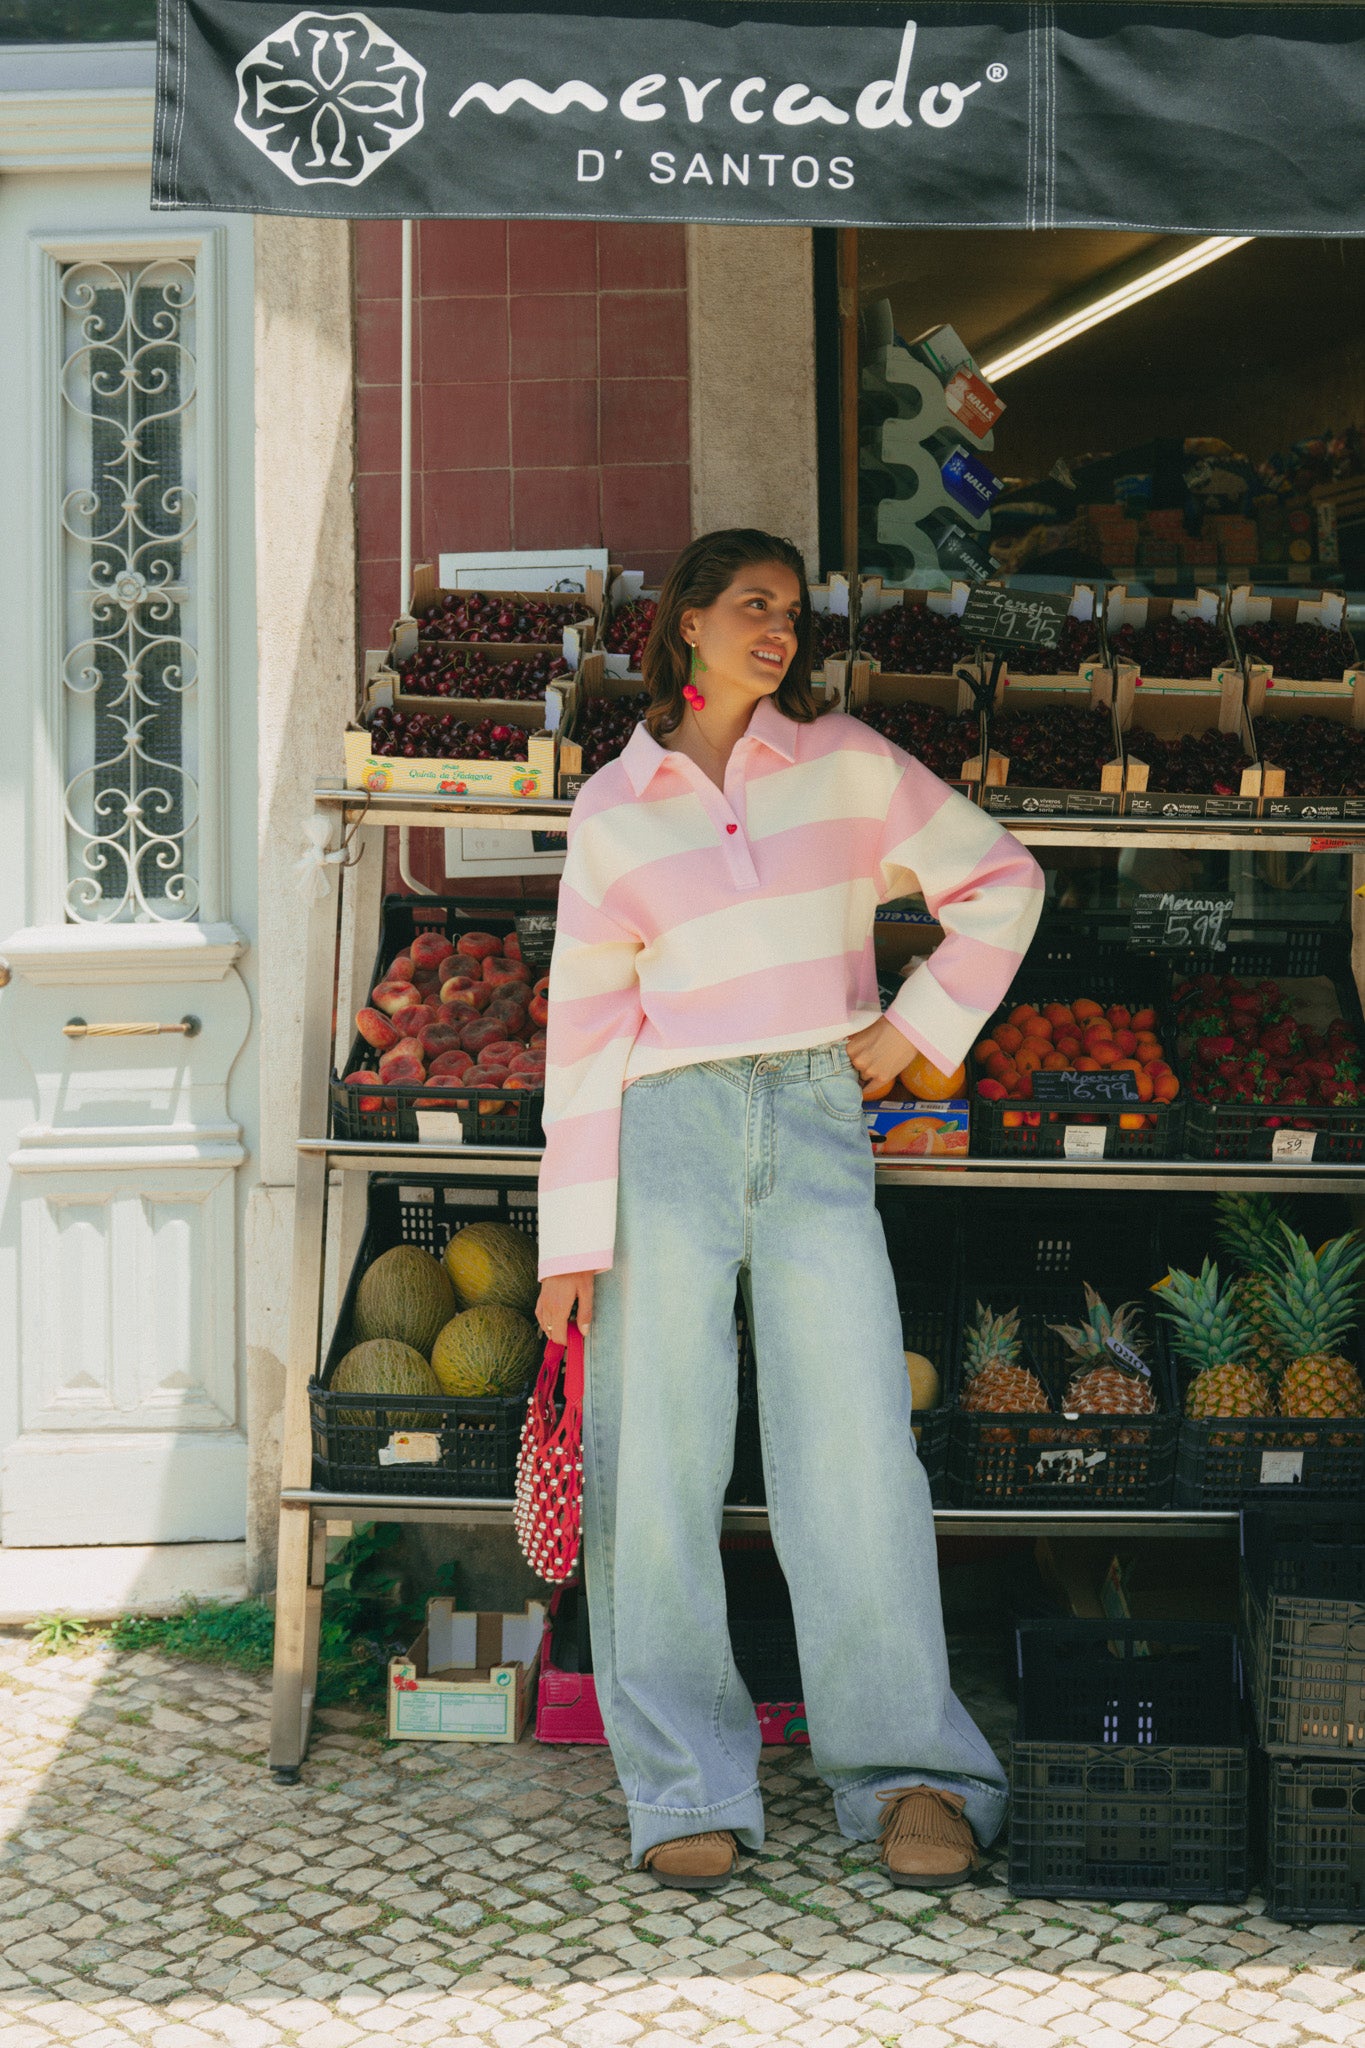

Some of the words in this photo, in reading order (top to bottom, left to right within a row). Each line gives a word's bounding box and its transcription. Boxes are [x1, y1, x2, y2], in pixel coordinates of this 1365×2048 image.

[448, 20, 982, 129] mercado
[649, 151, 855, 190] SANTOS
[966, 392, 995, 419] HALLS
[963, 471, 992, 500] HALLS
[960, 552, 989, 579] HALLS
[993, 594, 1056, 618] Cereja
[1000, 612, 1061, 641] 9.95
[1159, 893, 1234, 917] Morango
